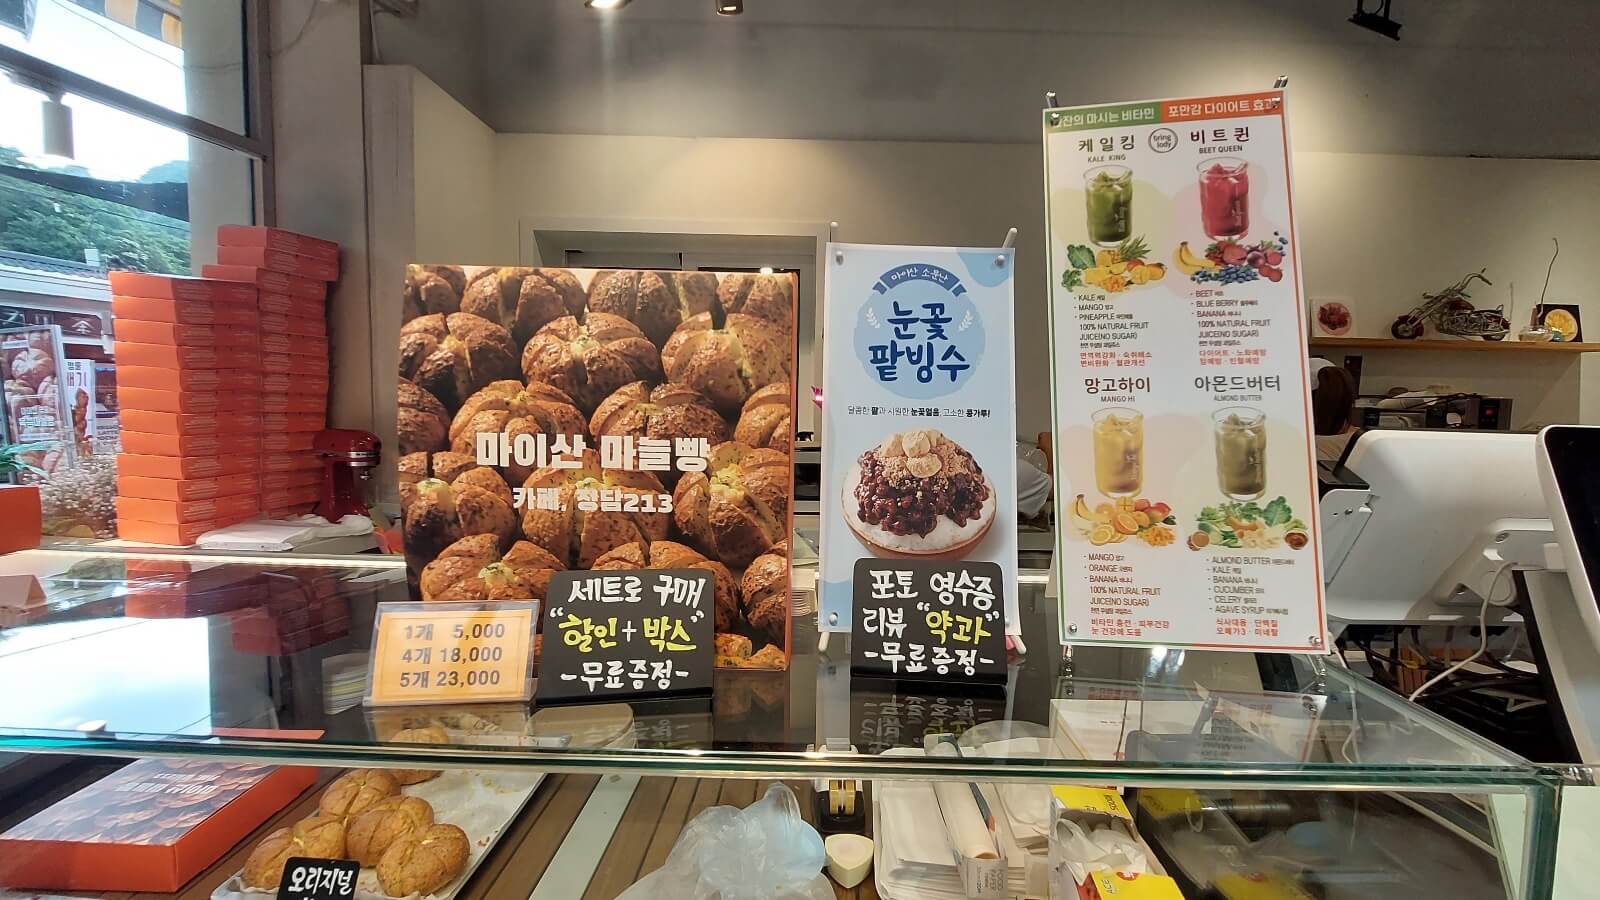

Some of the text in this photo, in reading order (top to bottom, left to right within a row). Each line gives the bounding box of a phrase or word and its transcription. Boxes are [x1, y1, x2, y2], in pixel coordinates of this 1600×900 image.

[1168, 104, 1201, 117] 포만감
[1204, 100, 1251, 114] 다이어트
[1056, 107, 1154, 128] 잔의 마시는 비타민
[1218, 145, 1242, 153] QUEEN
[921, 268, 948, 283] 소문난
[887, 301, 952, 340] 눈꽃
[1079, 313, 1115, 321] PINEAPPLE
[1251, 319, 1271, 327] FRUIT
[1080, 321, 1149, 331] 100% NATURAL FRUIT
[868, 340, 970, 383] 팥빙수
[1084, 377, 1151, 394] 망고하이
[1194, 375, 1281, 393] 아몬드버터
[888, 407, 909, 416] 시원한
[943, 408, 964, 417] 고소한
[476, 432, 711, 472] 마이산 마늘빵
[1089, 564, 1118, 572] ORANGE
[1212, 556, 1241, 564] ALMOND
[1243, 557, 1270, 565] BUTTER
[1212, 566, 1230, 574] KALE
[1089, 575, 1118, 583] BANANA
[568, 574, 706, 608] 세트로 구매
[869, 570, 996, 610] 포토 영수증
[1090, 586, 1161, 596] 100% NATURAL FRUIT
[1213, 586, 1254, 594] CUCUMBER
[1215, 606, 1240, 614] AGAVE
[1242, 606, 1264, 614] SYRUP
[862, 607, 907, 638] 리뷰
[404, 623, 505, 641] 1개 5,000
[402, 647, 503, 665] 4개 18,000
[400, 670, 500, 688] 5개 23,000
[288, 866, 354, 895] 오리지널
